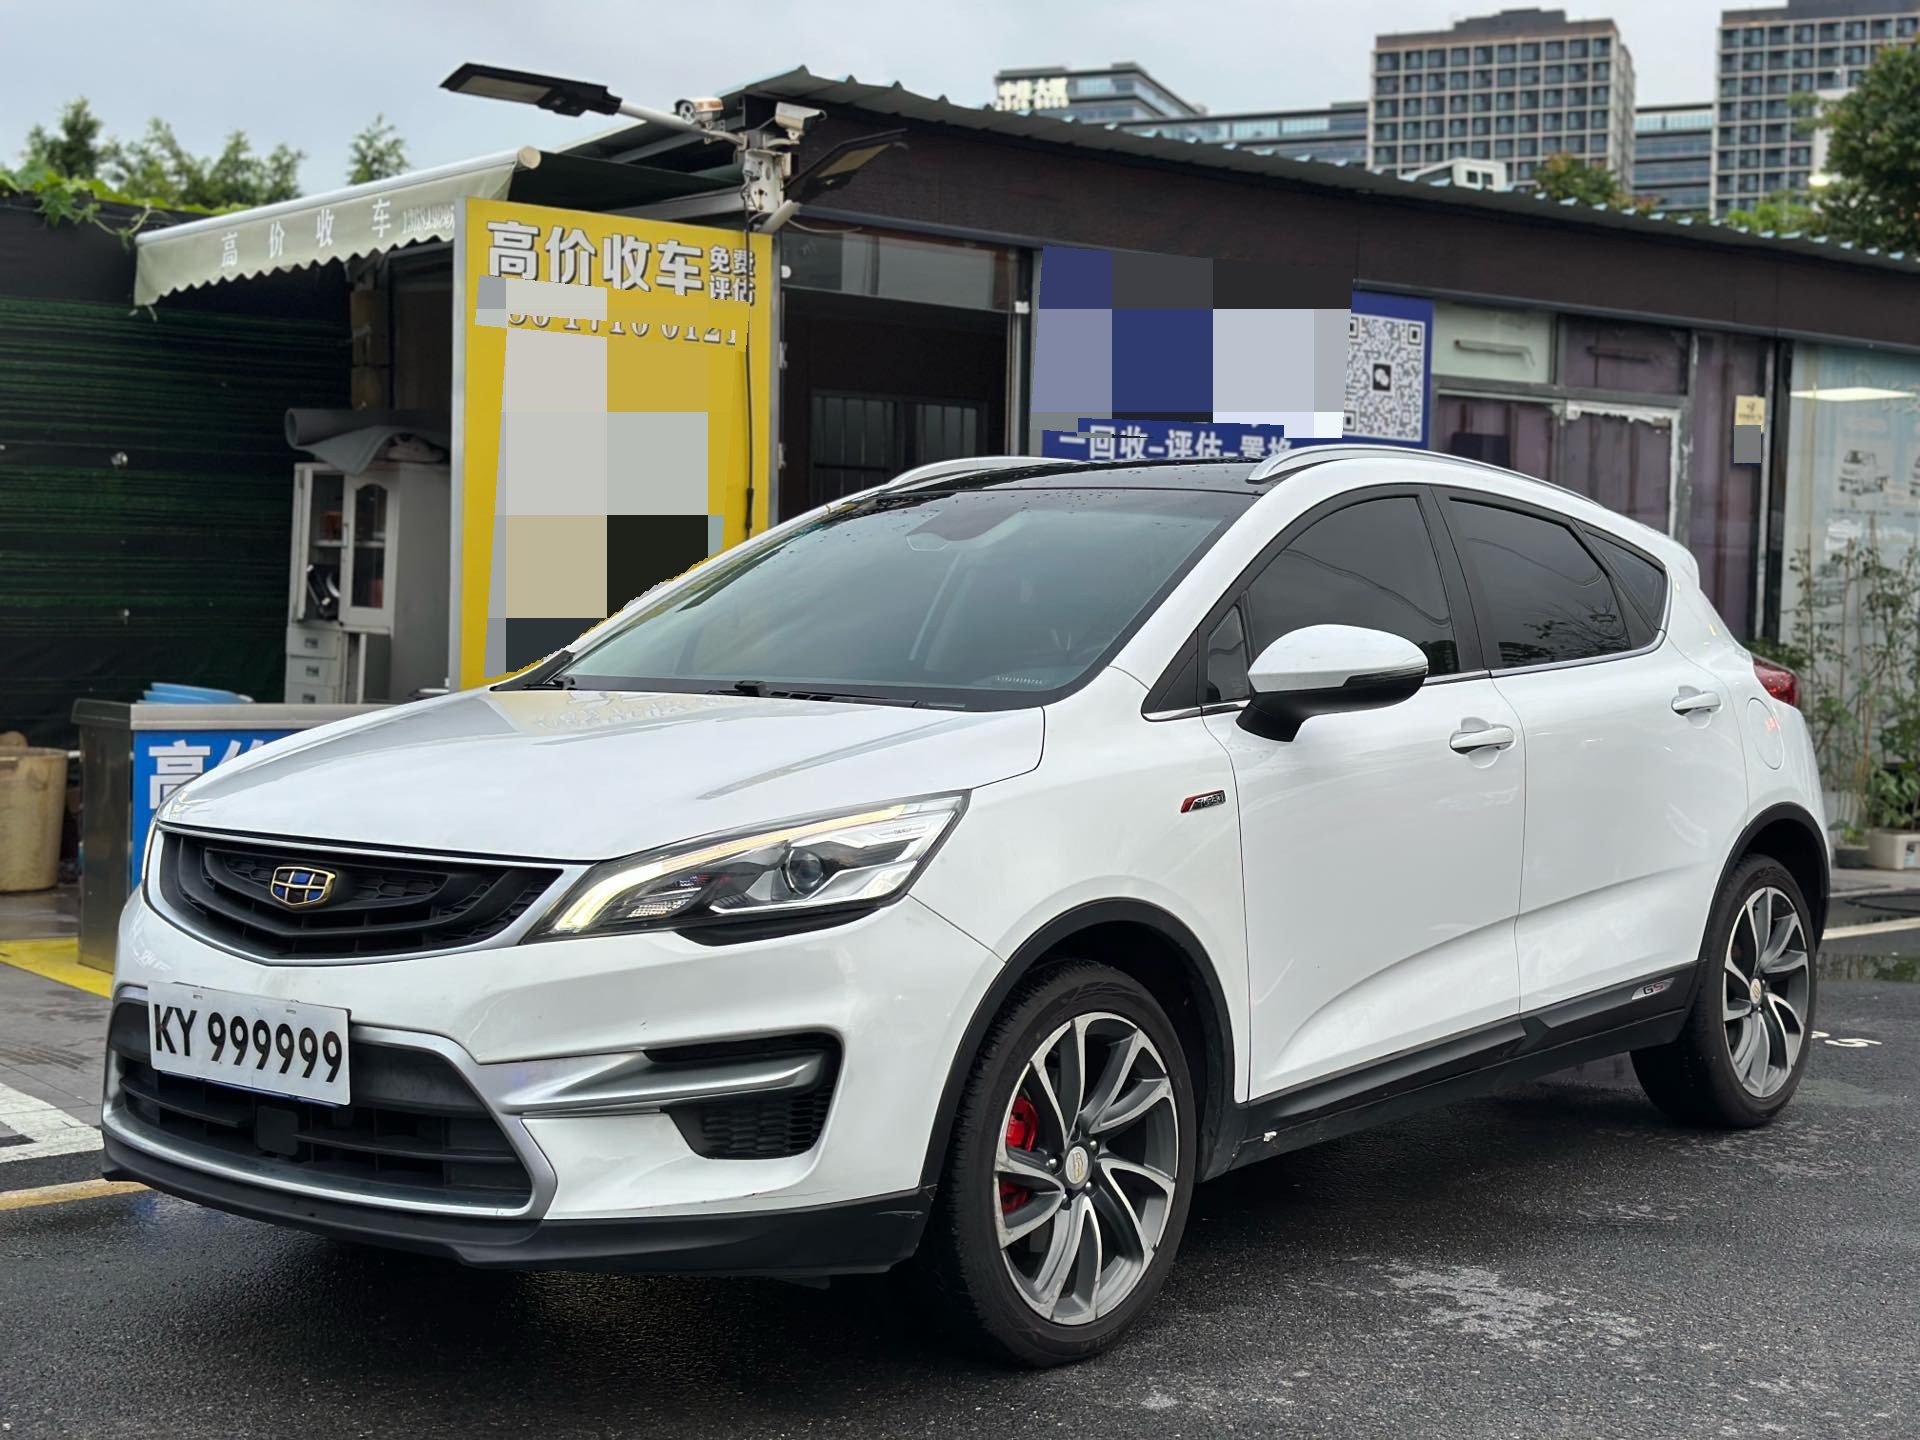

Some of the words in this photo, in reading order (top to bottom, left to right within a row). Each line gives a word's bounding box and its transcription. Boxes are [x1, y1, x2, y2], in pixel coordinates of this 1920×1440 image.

[222, 198, 391, 267] 高价收车
[487, 220, 703, 297] 高价收车
[709, 245, 755, 275] 免费
[709, 274, 755, 304] 评估
[1643, 982, 1665, 995] GS
[154, 1003, 197, 1057] KY
[207, 1011, 343, 1083] 999999
